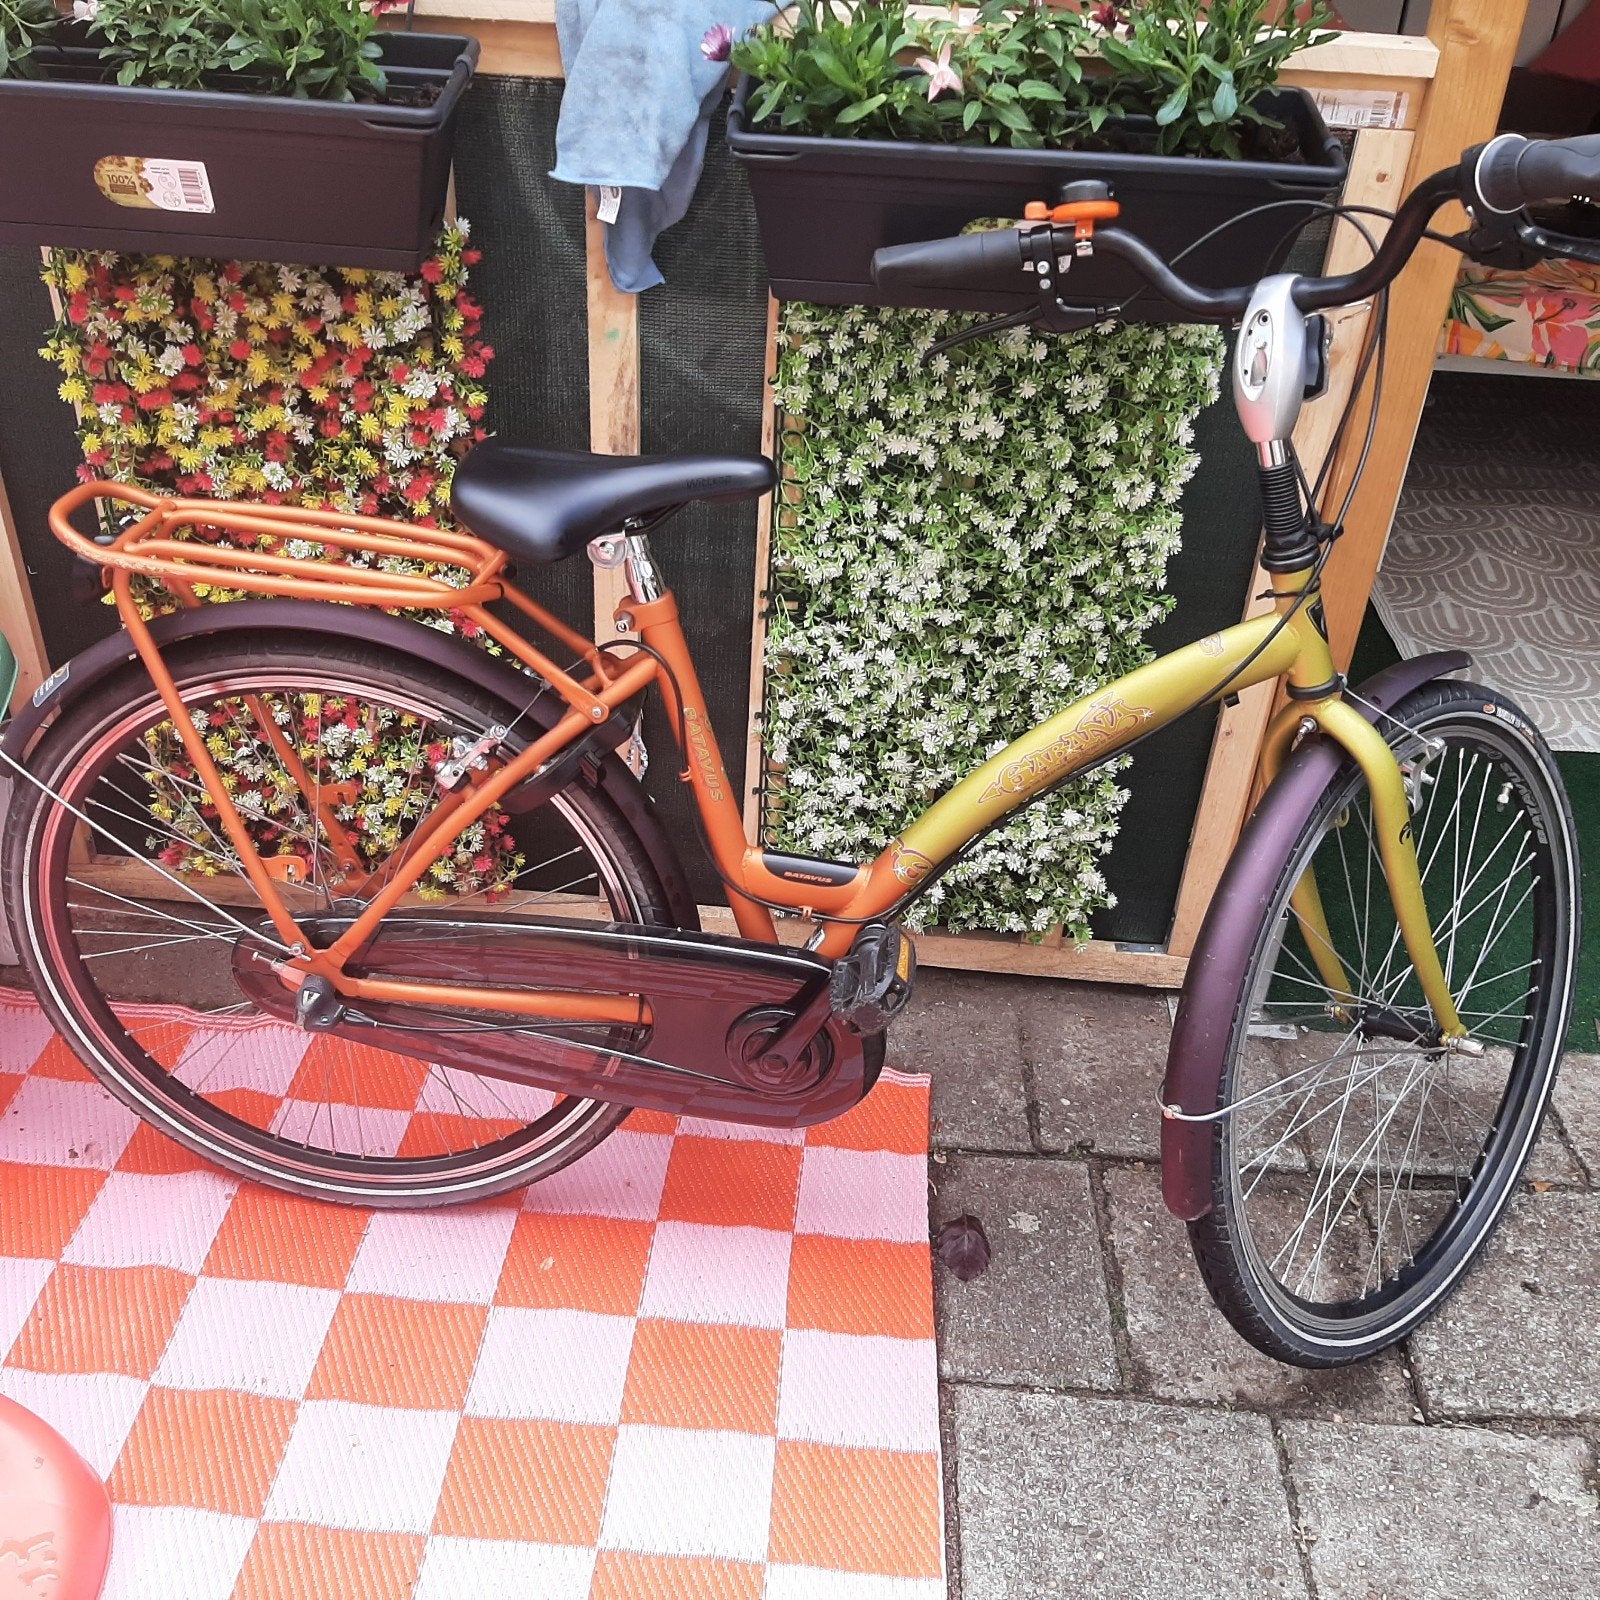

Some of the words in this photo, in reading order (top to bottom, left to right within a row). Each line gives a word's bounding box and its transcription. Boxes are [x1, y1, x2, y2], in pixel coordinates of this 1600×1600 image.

[107, 174, 135, 185] 100%
[683, 708, 724, 802] BATAVUS
[1501, 763, 1548, 844] BATAVUS
